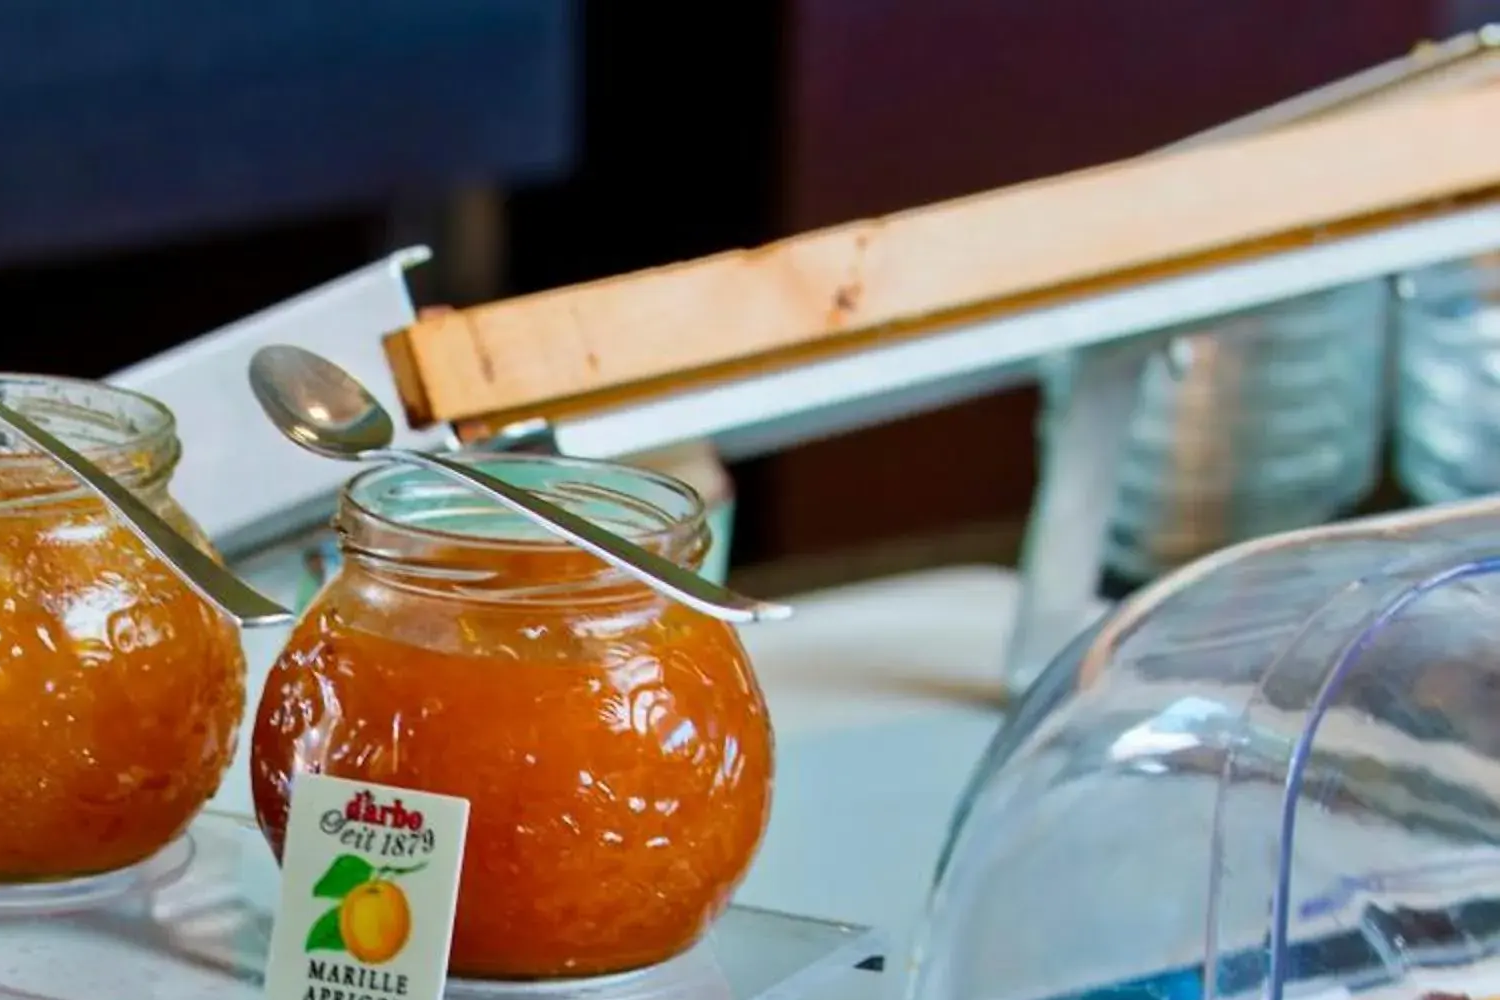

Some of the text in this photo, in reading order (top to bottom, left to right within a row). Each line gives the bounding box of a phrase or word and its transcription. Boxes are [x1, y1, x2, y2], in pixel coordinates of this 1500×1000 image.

[319, 809, 435, 856] Seit 1879
[308, 959, 408, 995] MARILLE
